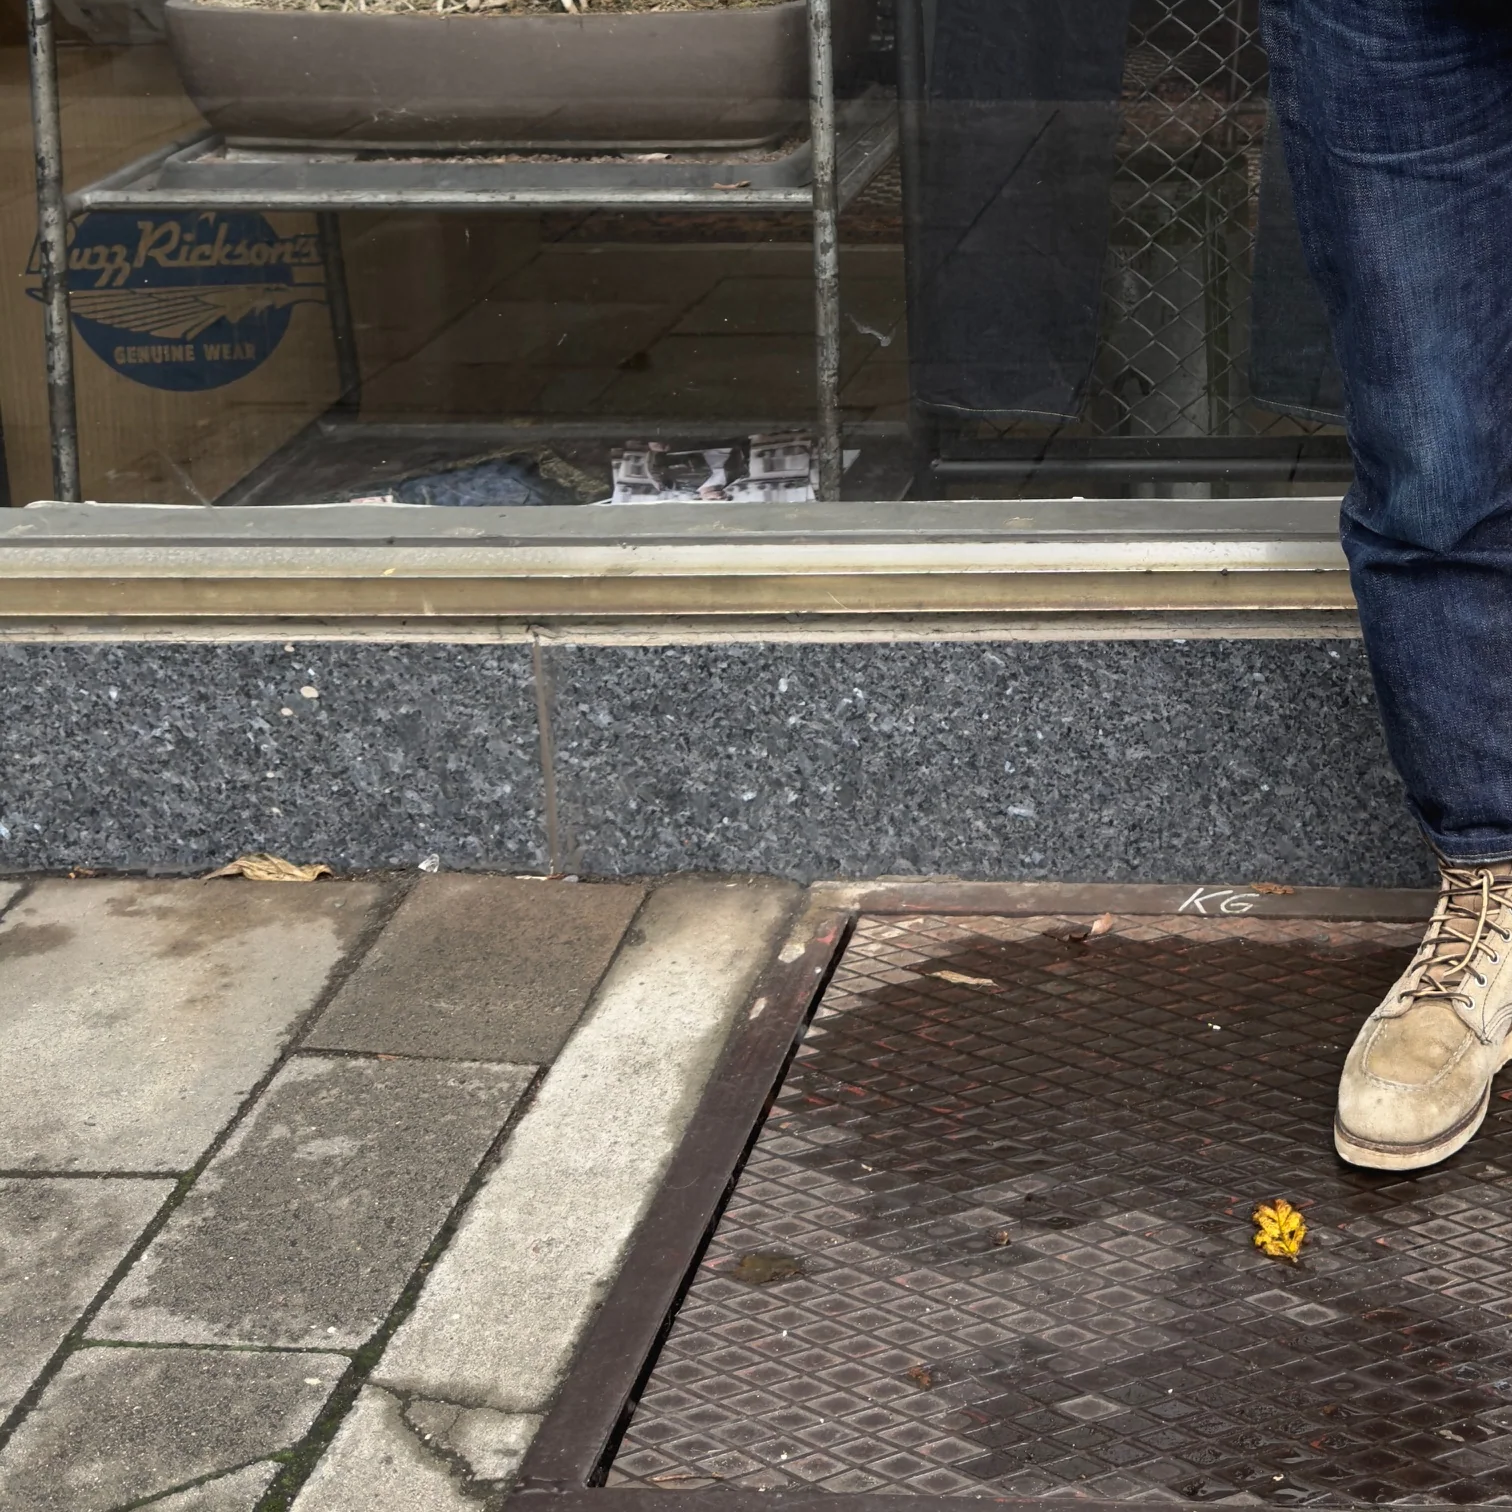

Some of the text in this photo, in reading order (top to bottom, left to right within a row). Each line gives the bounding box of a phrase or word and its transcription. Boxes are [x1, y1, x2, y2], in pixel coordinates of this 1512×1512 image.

[113, 342, 256, 366] GENUINE WEAR
[1178, 887, 1260, 914] KG
